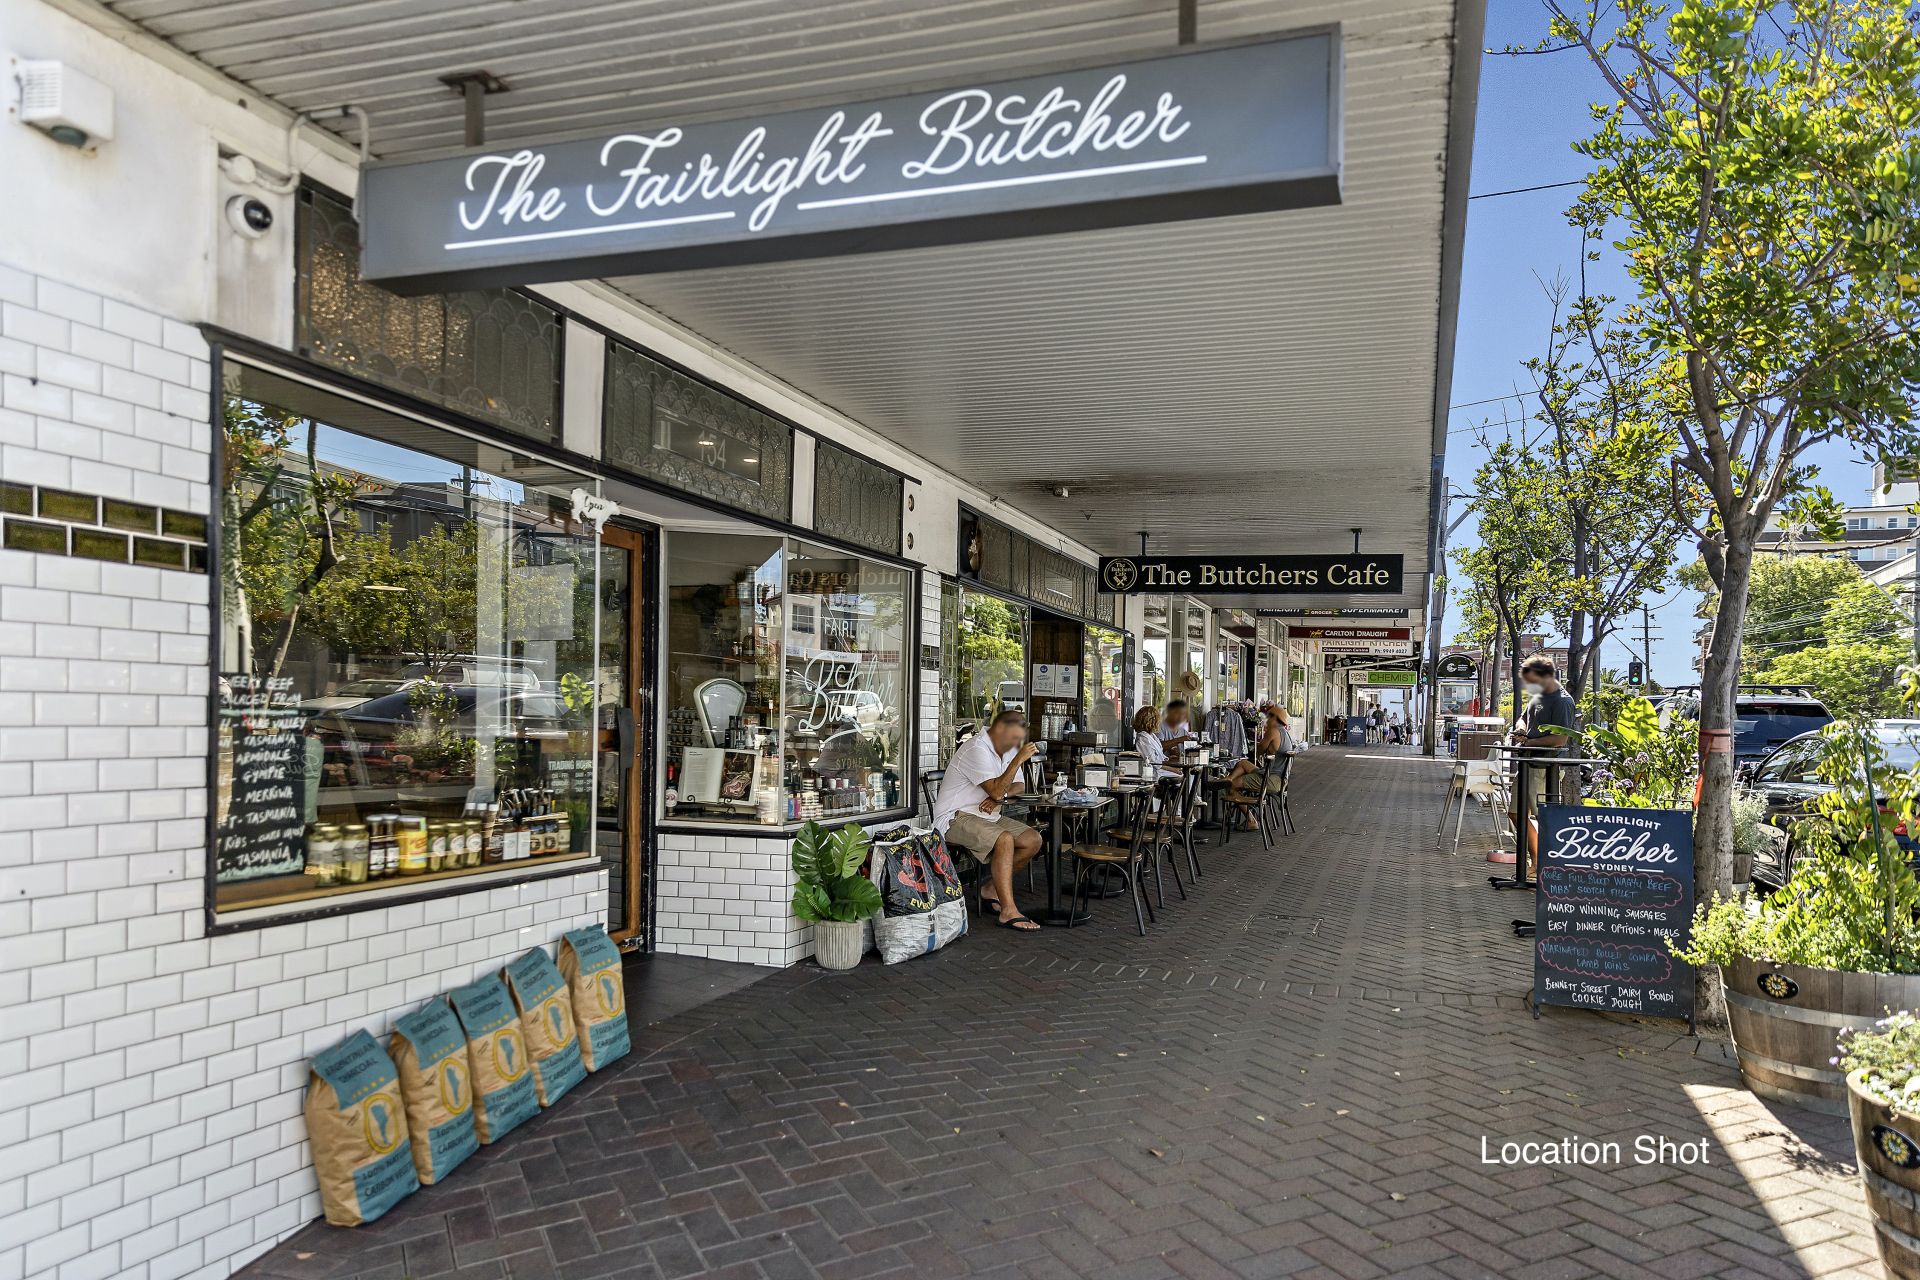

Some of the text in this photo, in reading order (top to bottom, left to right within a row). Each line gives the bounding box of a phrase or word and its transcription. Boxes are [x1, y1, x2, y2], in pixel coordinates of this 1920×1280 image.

[457, 73, 1190, 232] The Fairlight Butcher
[1142, 562, 1389, 586] The Butchers Cafe
[1357, 630, 1389, 638] DRAUGHT
[1369, 673, 1415, 682] CHEMIST
[798, 650, 897, 731] Butcher
[243, 732, 297, 747] TASMANIA
[235, 748, 291, 765] ARMIDALE
[548, 760, 575, 771] TRADING
[836, 756, 868, 768] SYDNEY
[242, 765, 286, 783] GYMPIE
[246, 802, 297, 825] TASMANIA
[1568, 814, 1662, 831] THE FAIRLIGHT
[237, 842, 291, 865] TASMANIA
[1547, 826, 1678, 863] Butcher
[1592, 862, 1635, 873] SYDNEY
[1568, 873, 1585, 884] FULL
[1613, 876, 1643, 890] WAGYU
[1647, 878, 1672, 891] BEEF
[1577, 885, 1605, 895] SCOTCH
[1547, 901, 1667, 921] AWARD WINNING SAUSAGES
[1547, 920, 1681, 938] EASY DINNER OPTIONS MEALS
[1576, 957, 1600, 968] LAMB
[1545, 978, 1675, 1003] BENNETT STREET DAIRY BONDI
[1571, 993, 1643, 1011] COOKIE DOUGH
